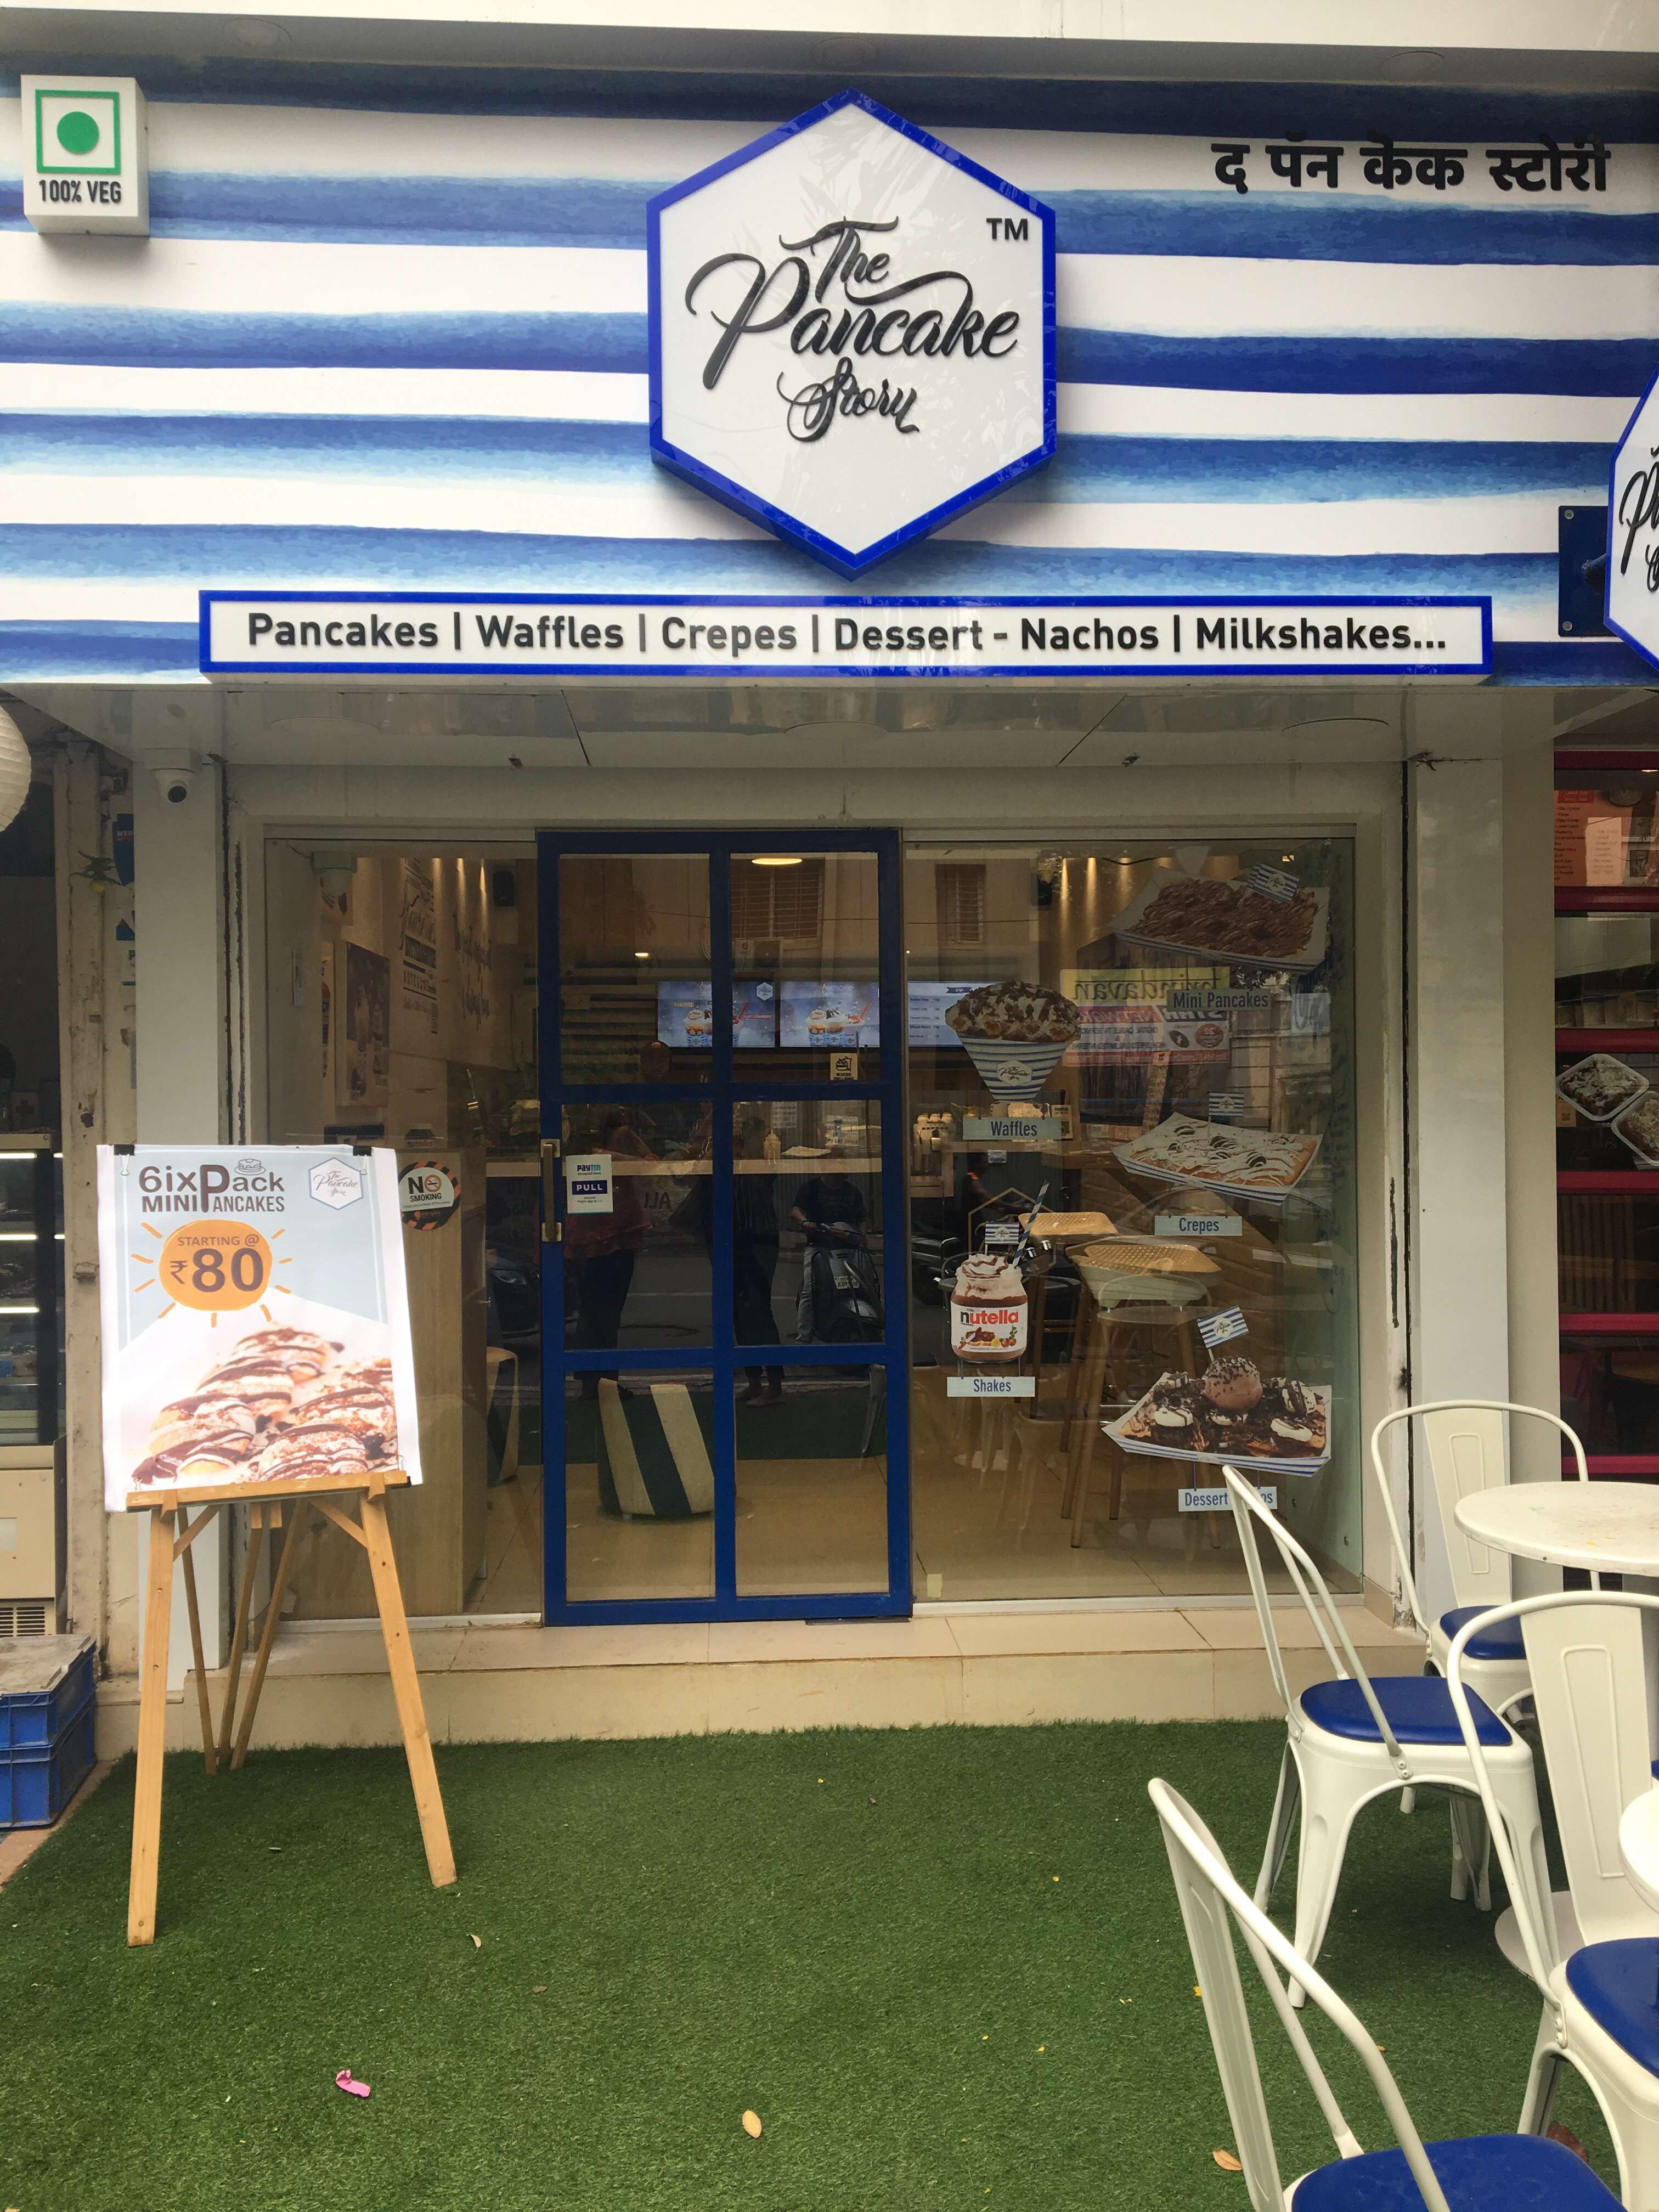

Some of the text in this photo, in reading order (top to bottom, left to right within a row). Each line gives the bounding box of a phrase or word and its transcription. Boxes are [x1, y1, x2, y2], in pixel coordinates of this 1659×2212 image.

[1211, 143, 1251, 194] द
[1359, 130, 1469, 190] केक
[1486, 133, 1612, 191] स्टोरी
[39, 179, 121, 203] 100% VEG
[986, 218, 1029, 240] TM
[779, 216, 898, 303] The
[685, 253, 1019, 390] Pancake
[777, 357, 920, 442] Story
[248, 612, 438, 647] Pancakes
[475, 614, 624, 649] Waffles
[662, 616, 797, 657] Crepes
[835, 618, 983, 650] Dessert
[1022, 618, 1159, 650] Nachos
[1173, 992, 1268, 1008] Mini Pancakes
[991, 1121, 1037, 1136] Waffles
[142, 1195, 198, 1212] MINI
[410, 1193, 442, 1203] SMOKING
[1180, 1218, 1220, 1234] Crepes
[177, 1236, 240, 1246] STARTING
[960, 1310, 1019, 1325] nutella
[974, 1379, 1011, 1392] Shakes
[1185, 1492, 1228, 1506] Dessert
